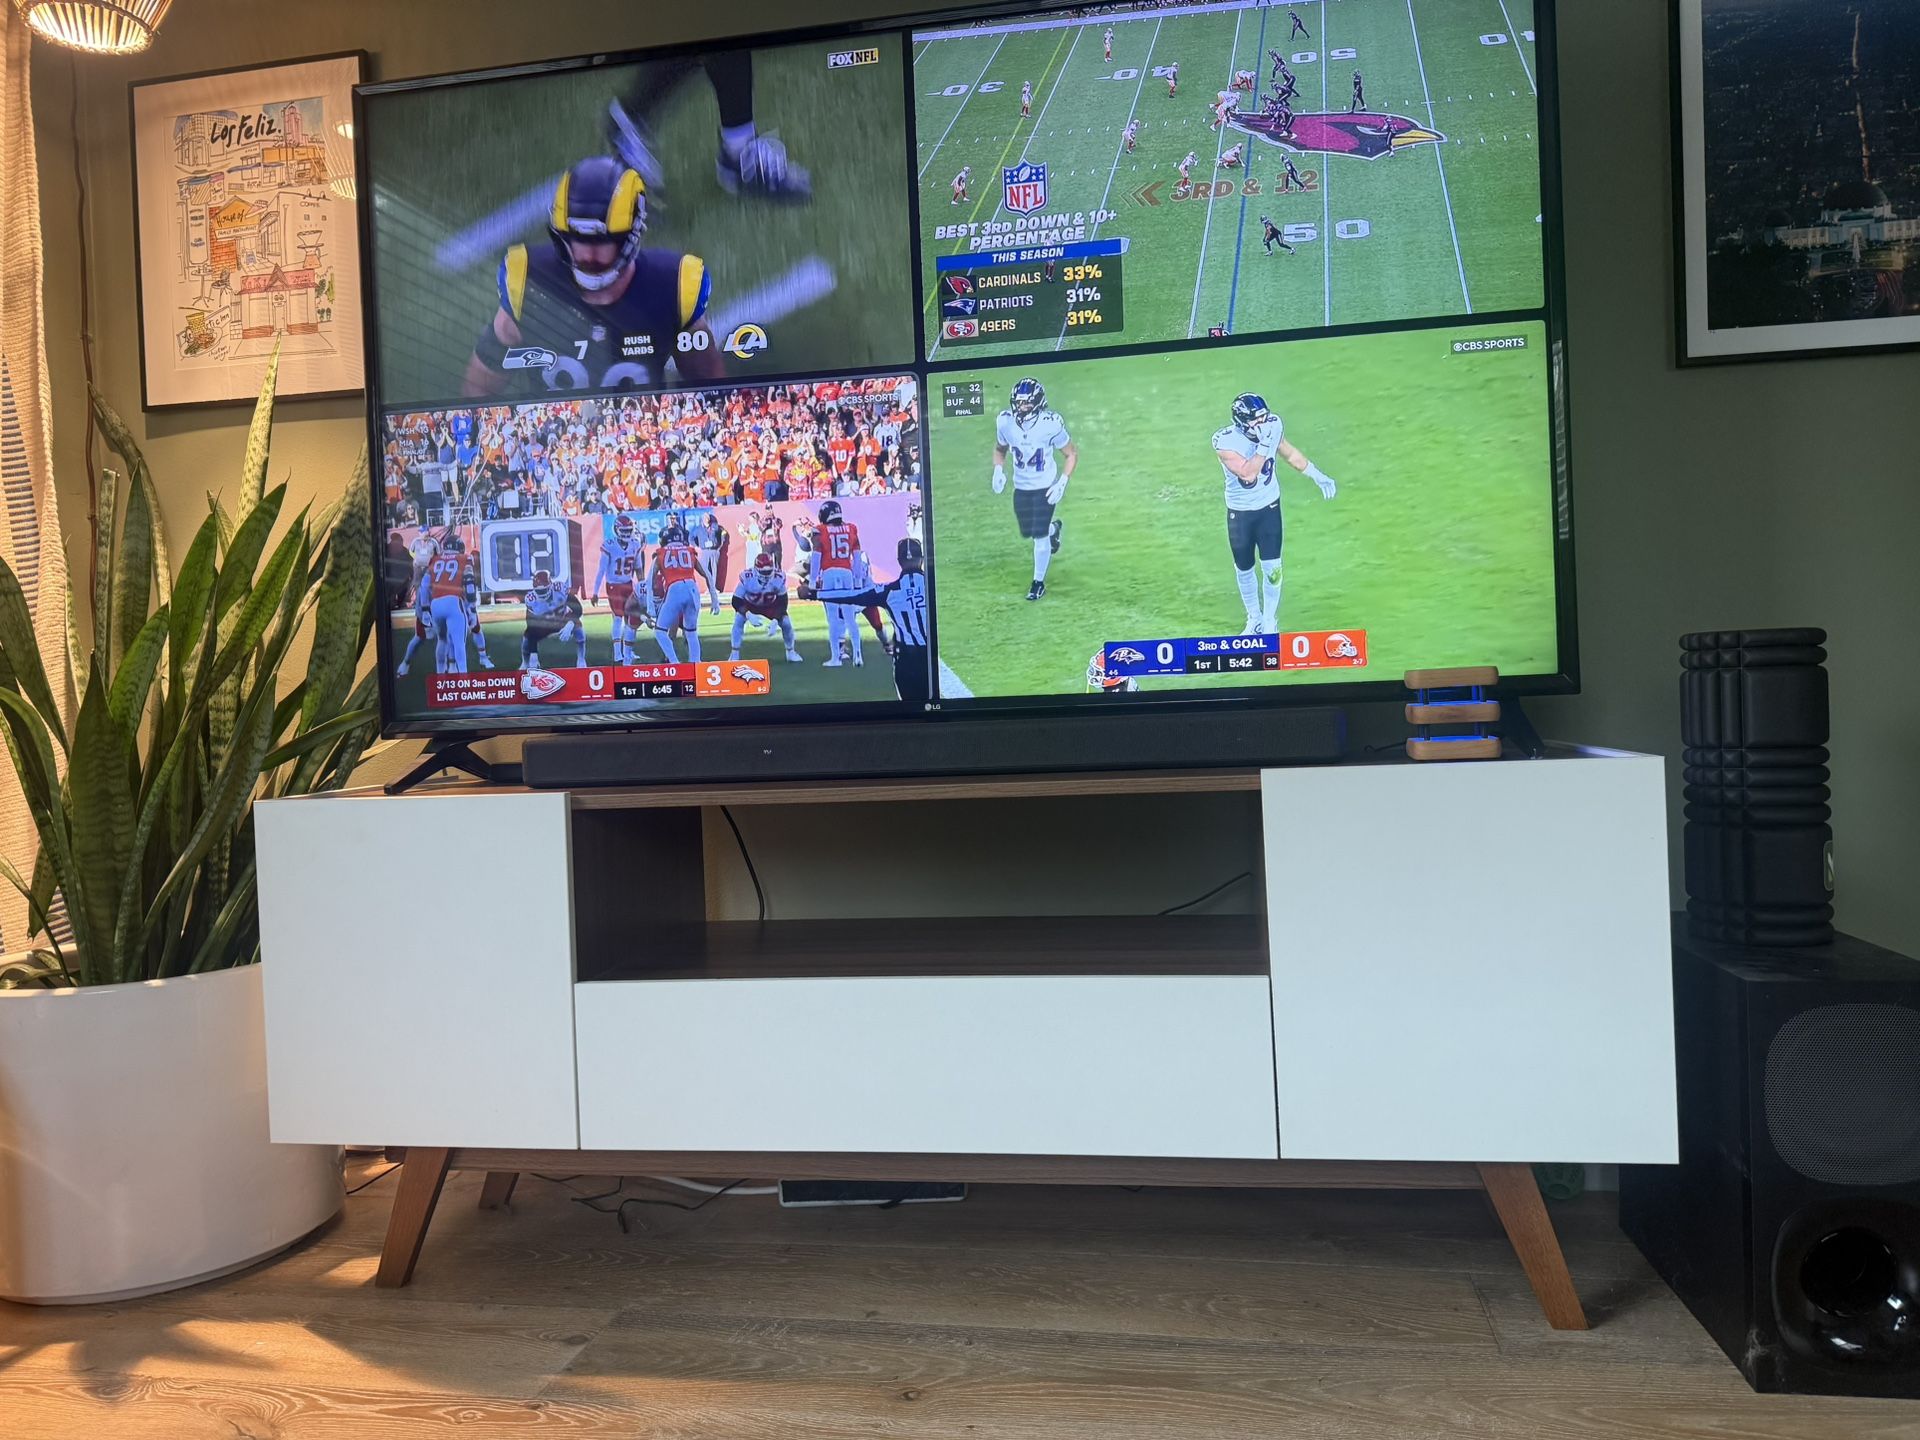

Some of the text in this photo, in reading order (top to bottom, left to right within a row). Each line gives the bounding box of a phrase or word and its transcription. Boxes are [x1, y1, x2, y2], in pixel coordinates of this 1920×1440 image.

[829, 50, 877, 67] FOX NFL
[211, 122, 235, 148] Los
[1170, 170, 1319, 202] 3RD & 12
[1008, 183, 1043, 209] NFL
[934, 209, 1117, 240] BEST 3RD DOWN & 10+
[969, 226, 1085, 250] PERCENTAGE
[992, 247, 1064, 263] THIS SEASON
[978, 264, 1102, 288] CARDINALS 33%
[979, 287, 1101, 310] PATRIOTS 31%
[980, 309, 1102, 333] 49ERS 31%
[574, 340, 588, 360] 7
[624, 335, 651, 346] RUSH
[677, 330, 709, 352] 80
[1462, 337, 1525, 351] CBS SPORTS
[622, 345, 654, 356] YARDS
[945, 383, 981, 394] TB 32
[846, 393, 898, 405] CBS SPORTS
[946, 396, 981, 407] BUF 44
[399, 439, 414, 447] MIA
[830, 534, 850, 559] 15
[614, 557, 635, 576] 15
[665, 550, 692, 569] 40
[433, 559, 459, 582] 99
[906, 587, 921, 596] BJ
[906, 595, 926, 610] 12
[1156, 642, 1174, 665] 0
[1197, 637, 1267, 651] 3RD & GOAL
[1292, 635, 1310, 659] 0
[633, 667, 676, 678] 3RD & 10
[1194, 657, 1277, 669] 1ST 5:42 38
[436, 678, 516, 690] 3/13 ON 3RD DOWN
[588, 670, 604, 691] 0
[706, 665, 721, 686] 3
[436, 692, 459, 701] LAST
[461, 691, 486, 700] GAME
[497, 690, 516, 699] BUF
[621, 684, 694, 695] 1ST 6:45 12
